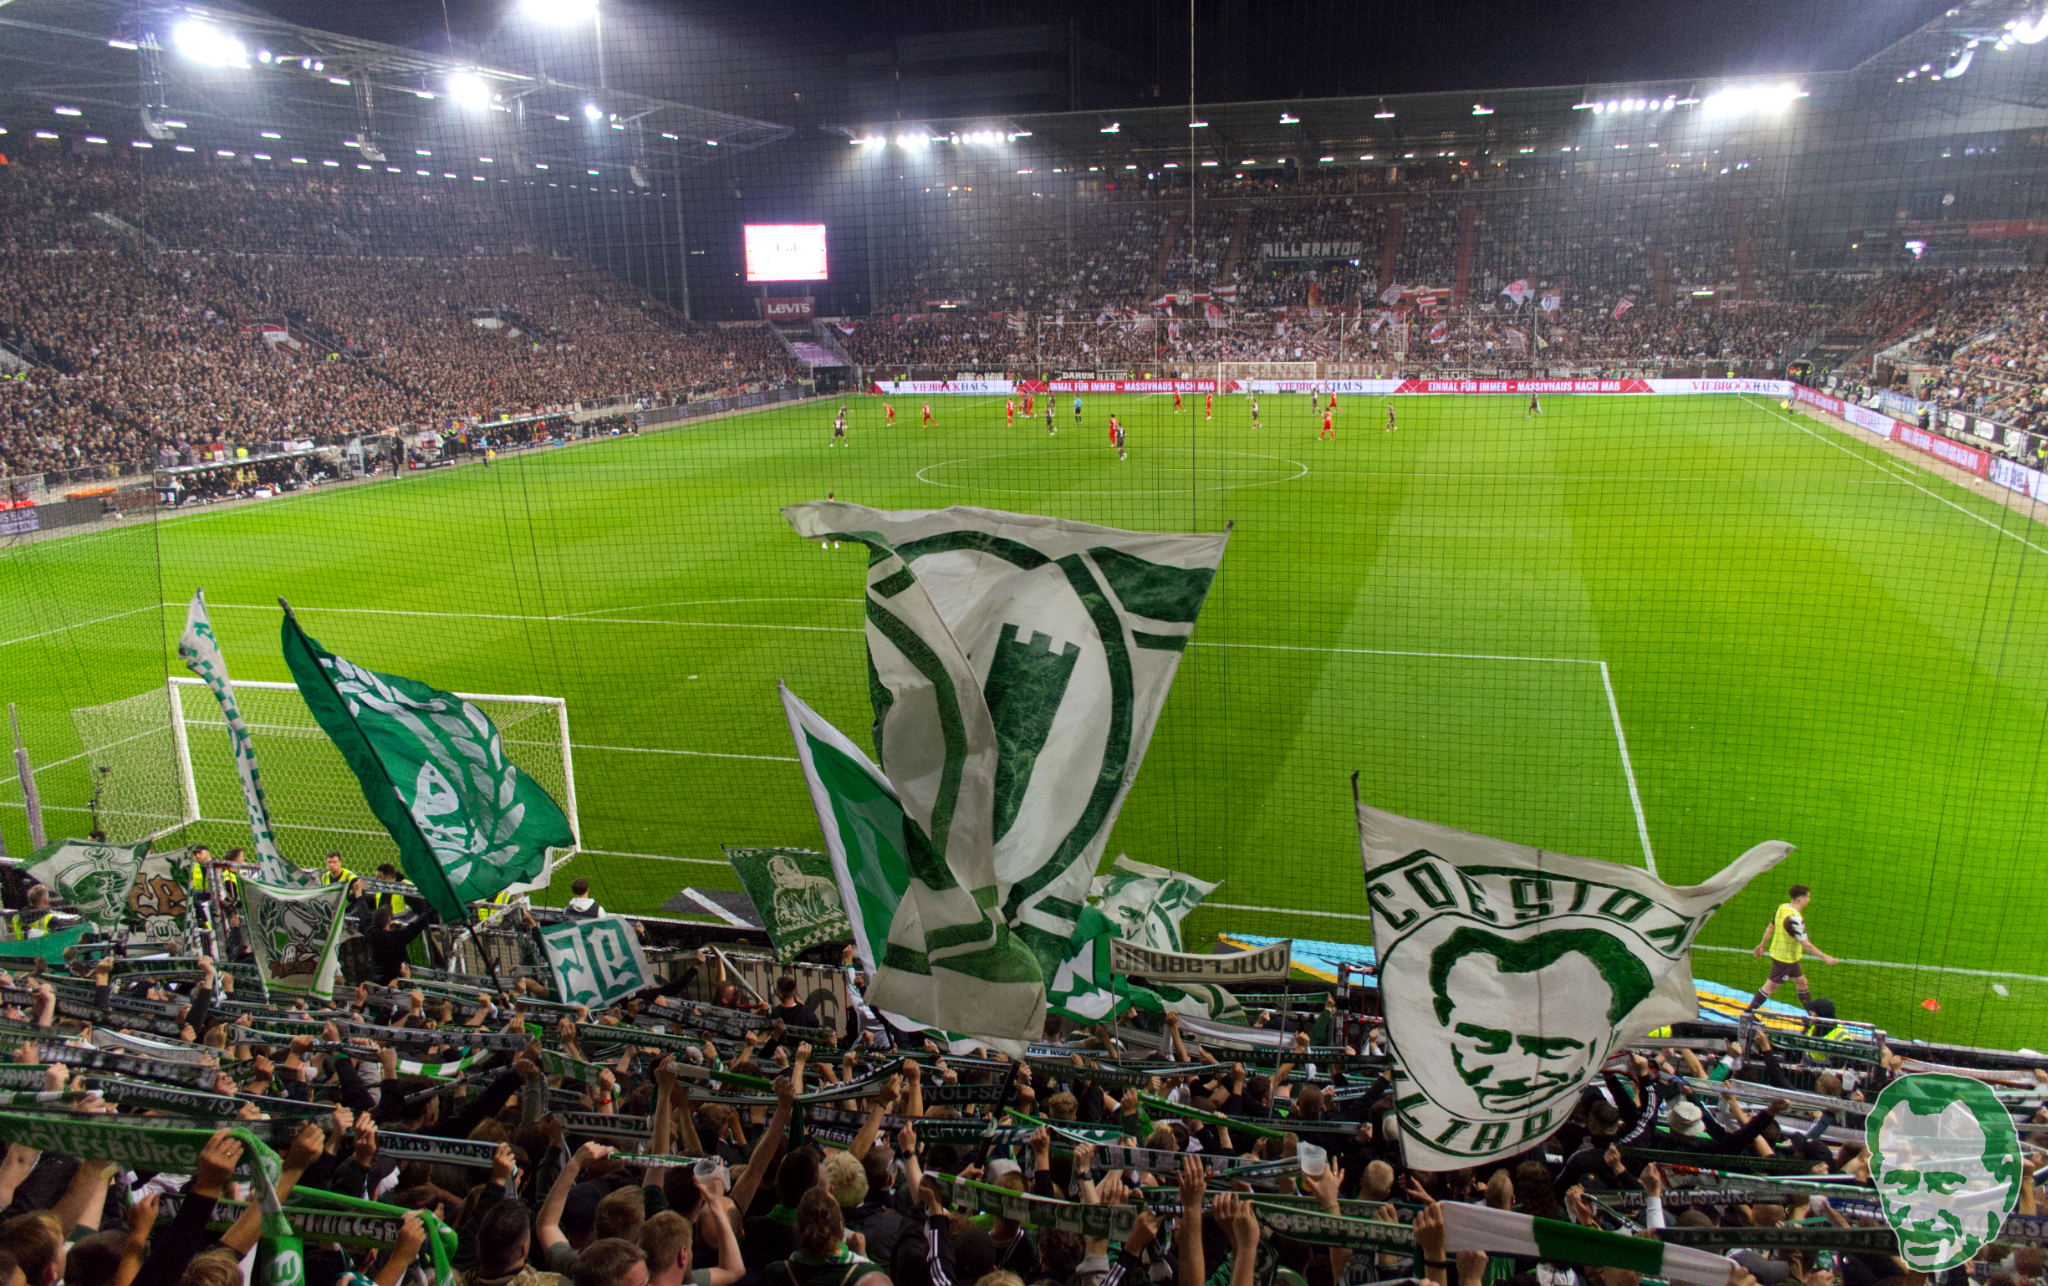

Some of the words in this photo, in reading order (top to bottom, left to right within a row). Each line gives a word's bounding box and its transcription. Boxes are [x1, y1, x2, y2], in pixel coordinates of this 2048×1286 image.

[1262, 241, 1361, 257] MILLERNTOR
[1062, 372, 1095, 380] DARUM
[1048, 382, 1072, 391] INMAL
[1074, 380, 1089, 391] FÜR
[1091, 382, 1116, 391] IMMER
[1124, 382, 1172, 391] MASSIVHAUS
[1175, 382, 1195, 391] NACH
[1277, 382, 1363, 392] VIEBROCKHAUS
[1428, 382, 1458, 391] EINMAL
[1461, 380, 1477, 391] FÜR
[1479, 382, 1507, 391] IMMER
[1517, 382, 1572, 391] MASSIVHAUS
[1574, 382, 1599, 391] NACH
[1692, 381, 1780, 392] VIEBROCKHAUS
[436, 1141, 494, 1159] WOLFS
